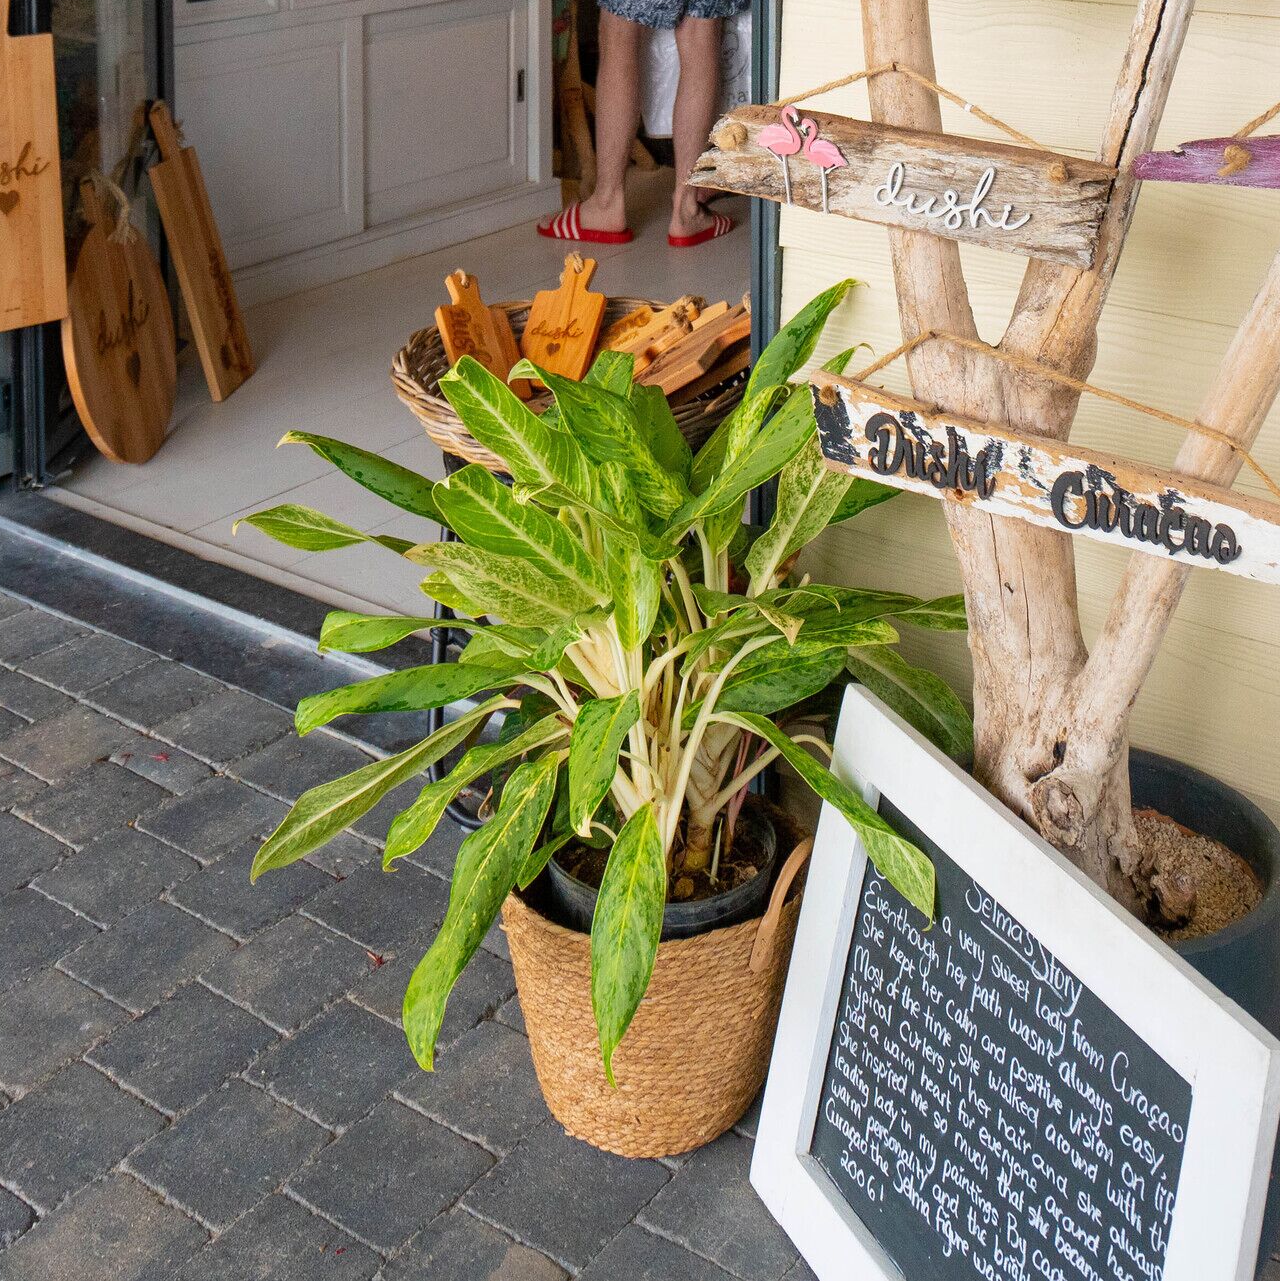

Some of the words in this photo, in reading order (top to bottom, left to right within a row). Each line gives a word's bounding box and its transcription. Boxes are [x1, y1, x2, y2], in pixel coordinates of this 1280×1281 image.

[873, 162, 1031, 232] dushi
[530, 319, 584, 340] dushi
[864, 412, 997, 500] Dushi
[1049, 469, 1242, 565] Curaçao
[862, 912, 885, 948] She
[888, 936, 916, 980] kept
[921, 966, 941, 1005] her
[980, 1034, 1007, 1065] and
[1009, 1056, 1063, 1115] positive
[1069, 1108, 1114, 1167] vision
[1120, 1161, 1145, 1202] on
[864, 880, 940, 978] Eventhough
[945, 945, 968, 992] her
[969, 978, 1003, 1019] path
[1058, 1048, 1113, 1132] always
[942, 915, 952, 937] a
[958, 929, 985, 983] very
[990, 954, 1030, 1003] sweet
[1030, 986, 1070, 1057] lady
[1071, 1018, 1105, 1073] from
[1110, 1050, 1184, 1143] Curaçao
[1030, 943, 1083, 1017] Story
[825, 1096, 868, 1155] Curaçao
[869, 1138, 890, 1177] the
[892, 1159, 931, 1226] Selma
[935, 1199, 970, 1258] figure
[830, 1078, 862, 1122] warm
[865, 1115, 930, 1192] personality
[931, 1174, 960, 1219] and
[966, 1205, 988, 1247] the
[834, 1045, 870, 1108] leading
[873, 1086, 899, 1132] lady
[900, 1107, 912, 1140] in
[915, 1132, 937, 1176] my
[1006, 1211, 1027, 1270] By
[839, 1020, 859, 1058] She
[861, 1030, 908, 1113] inspired
[910, 1088, 929, 1118] me
[933, 1110, 948, 1135] so
[954, 1131, 989, 1181] much
[996, 1166, 1025, 1214] that
[840, 1149, 884, 1213] 2006!
[844, 995, 867, 1033] had
[869, 1024, 879, 1045] a
[883, 1036, 915, 1076] warm
[920, 1065, 952, 1113] heart
[957, 1097, 976, 1130] for
[978, 1126, 1038, 1194] everyone
[1044, 1195, 1101, 1258] around
[849, 972, 893, 1039] typical
[948, 1059, 962, 1093] in
[968, 1076, 992, 1119] her
[997, 1108, 1032, 1156] hair
[1031, 1153, 1069, 1200] and
[853, 944, 885, 992] Most
[886, 976, 901, 1001] of
[901, 985, 921, 1019] the
[922, 1005, 952, 1048] time
[988, 1069, 1040, 1130] walked
[1044, 1123, 1099, 1184] around
[1106, 1178, 1142, 1235] with
